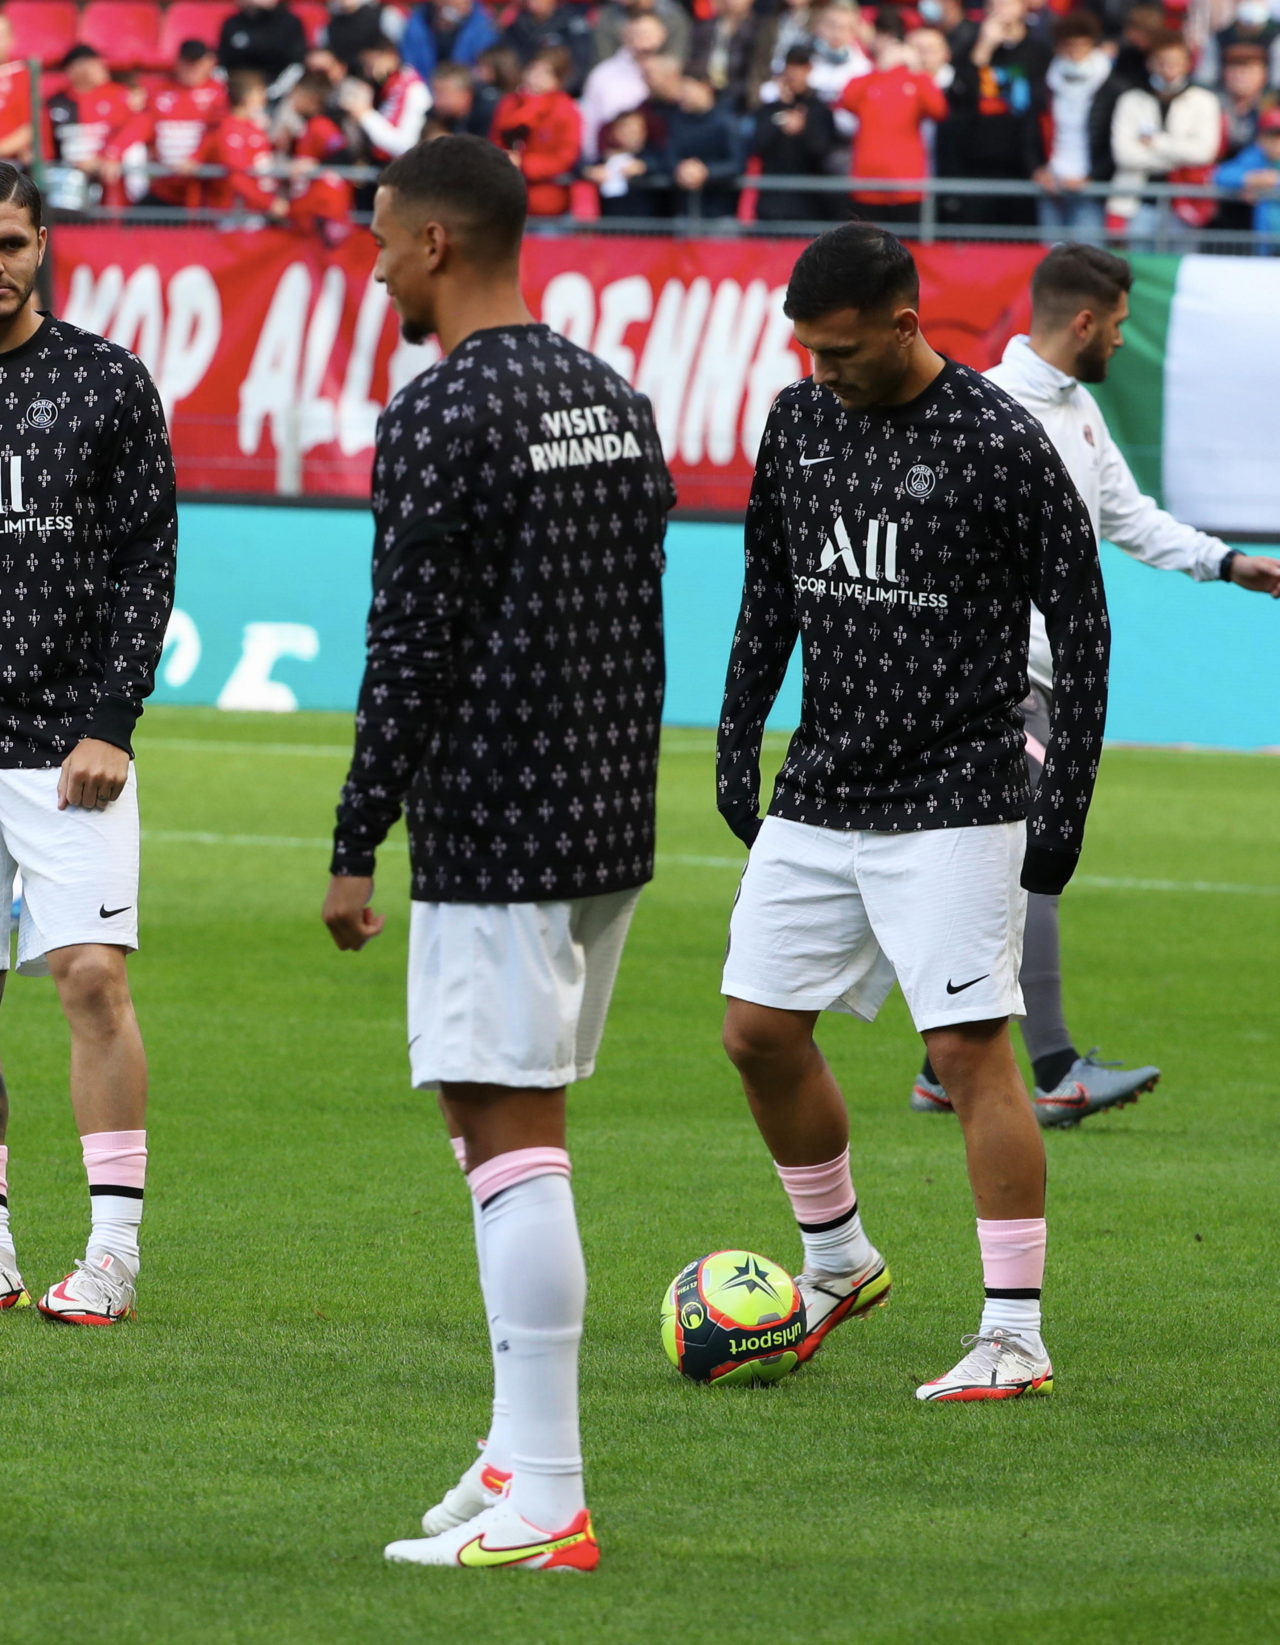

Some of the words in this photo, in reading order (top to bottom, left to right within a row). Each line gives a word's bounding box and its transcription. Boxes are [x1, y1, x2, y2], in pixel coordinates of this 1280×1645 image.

[542, 405, 608, 438] VISIT
[528, 431, 642, 472] RWANDA
[830, 580, 863, 598] LIVE
[866, 586, 948, 607] LIMITLESS
[729, 1321, 802, 1355] uhlsport
